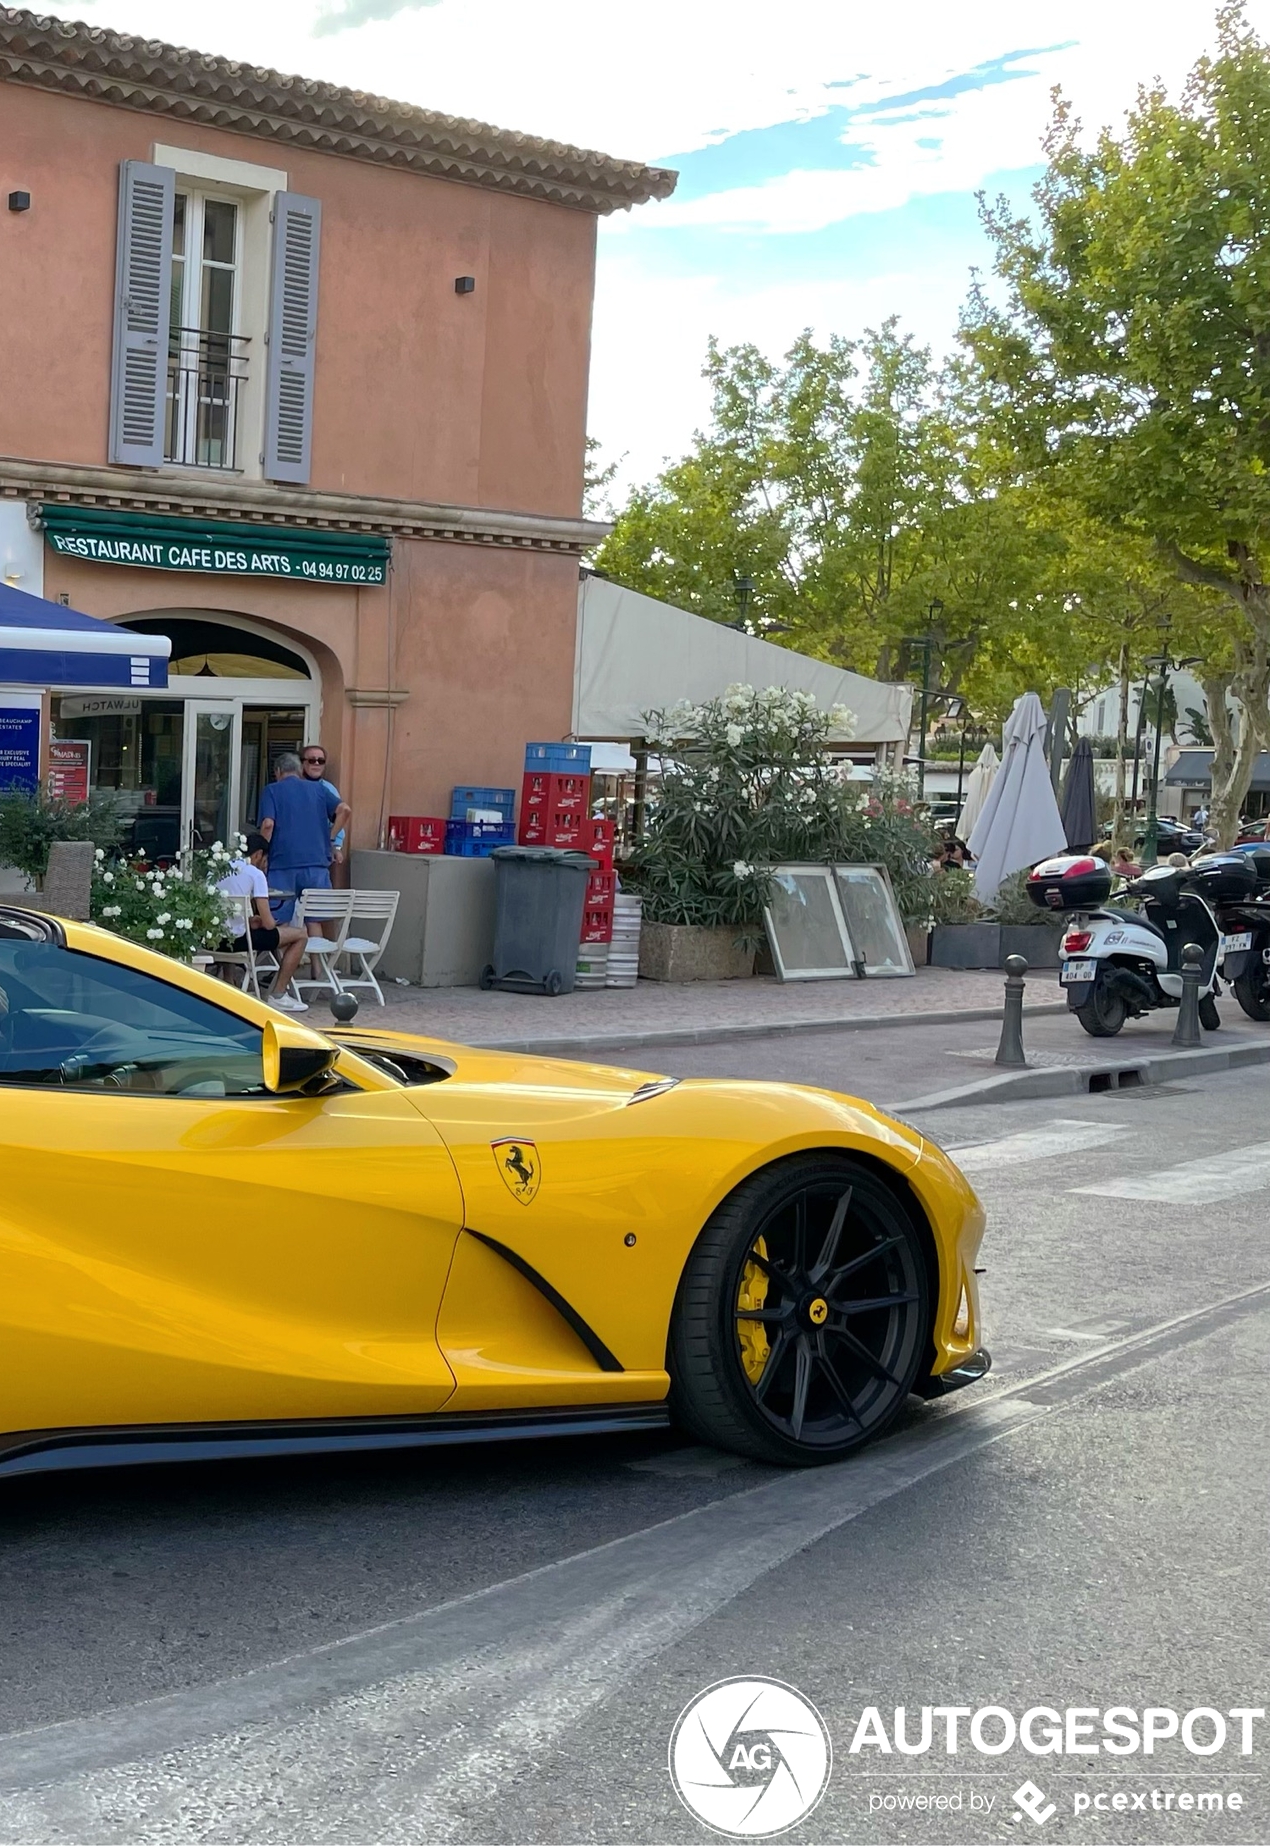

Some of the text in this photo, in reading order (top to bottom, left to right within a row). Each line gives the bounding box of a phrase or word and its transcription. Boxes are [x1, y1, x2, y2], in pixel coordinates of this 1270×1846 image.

[53, 534, 164, 563] RESTAURANT
[168, 546, 212, 568] CAFE
[214, 550, 248, 570] DES
[251, 553, 291, 573] ARTS
[302, 560, 317, 577] 04
[318, 562, 334, 578] 94
[335, 563, 349, 579] 97
[351, 565, 366, 580] 02
[368, 566, 383, 581] 25
